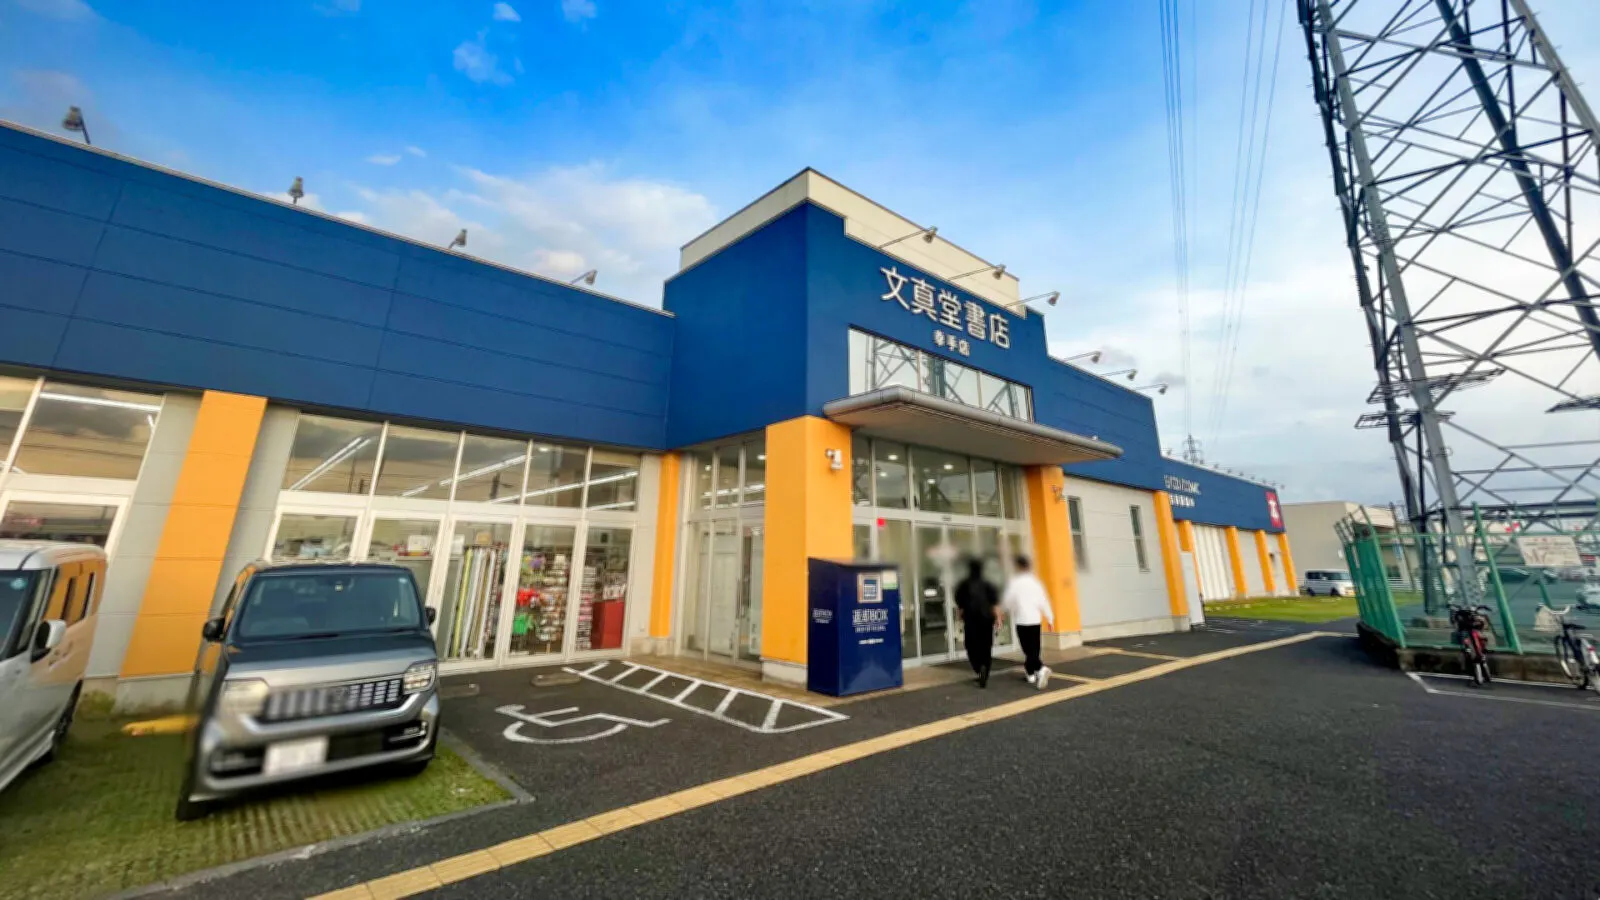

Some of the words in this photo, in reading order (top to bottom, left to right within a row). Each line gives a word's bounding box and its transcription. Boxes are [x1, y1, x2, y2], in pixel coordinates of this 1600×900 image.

[880, 266, 1010, 349] 文真堂書店
